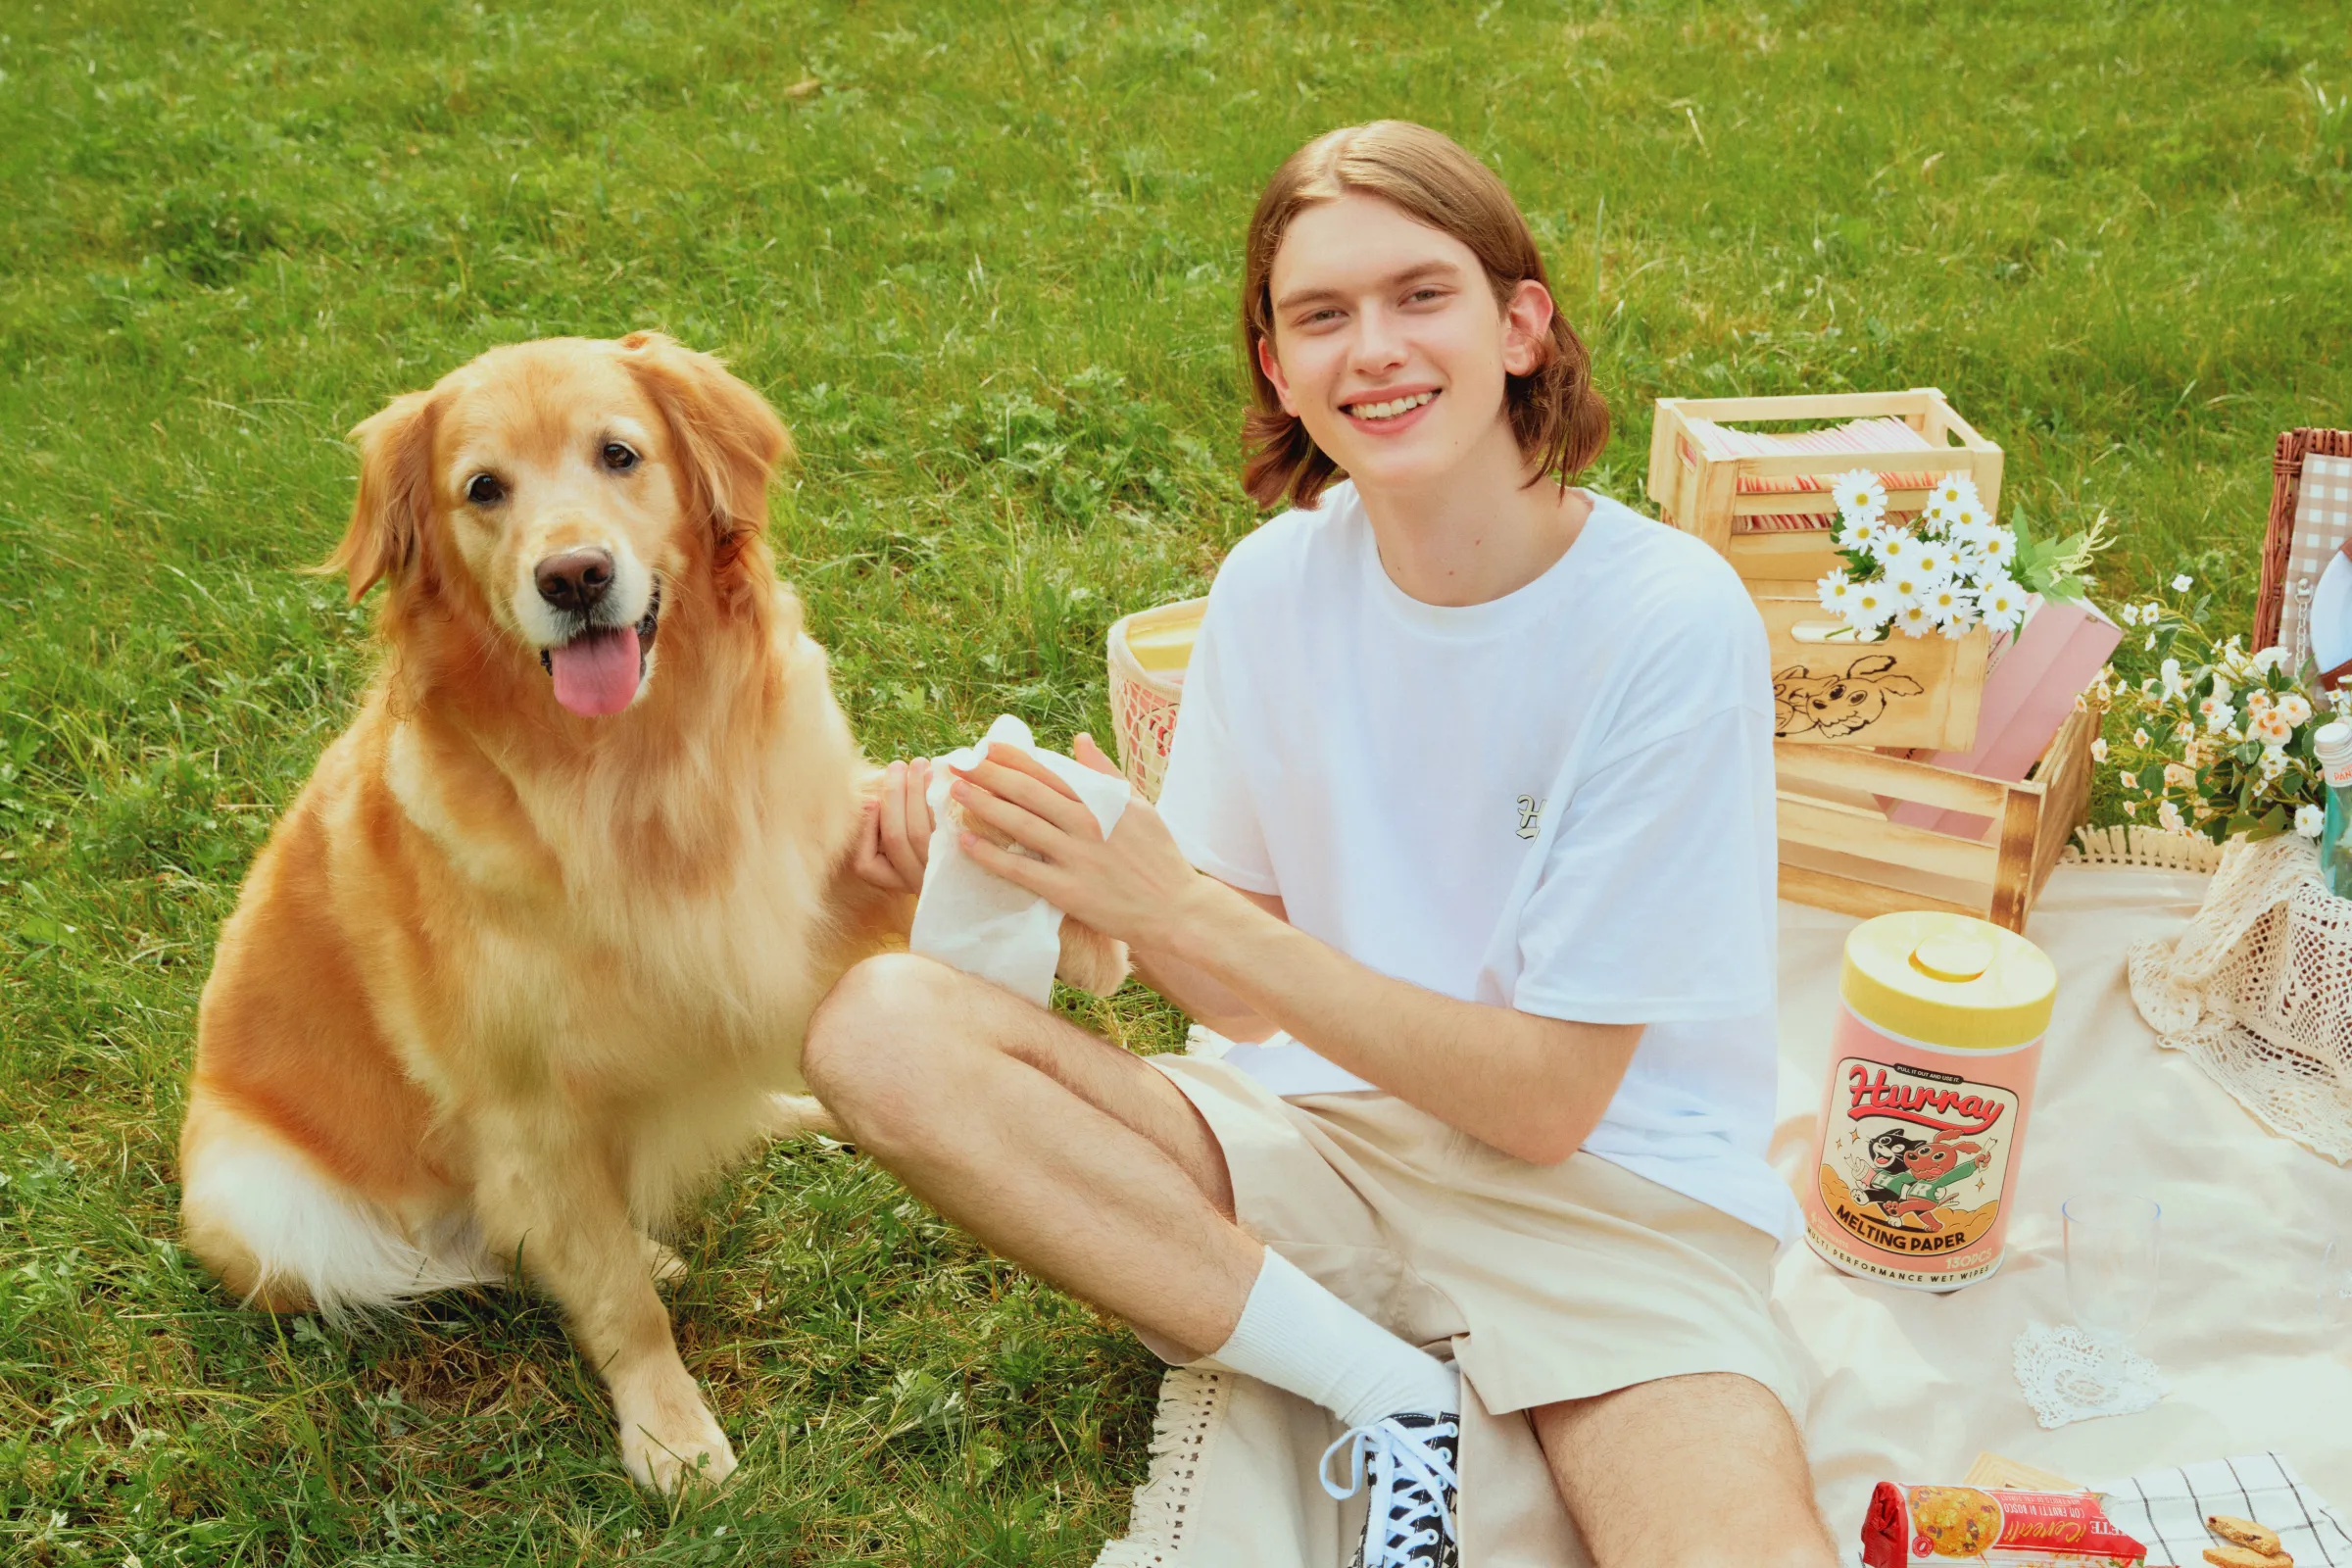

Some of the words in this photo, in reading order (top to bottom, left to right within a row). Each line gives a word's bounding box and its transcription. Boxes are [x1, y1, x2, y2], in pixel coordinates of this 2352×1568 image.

[1897, 1065, 1910, 1074] PULL
[1847, 1064, 2005, 1129] Hurray
[1836, 1203, 1907, 1250] MELTING
[1910, 1231, 1966, 1251] PAPER
[1807, 1226, 1830, 1251] MULTI
[1833, 1249, 1924, 1283] PERFORMANCE
[1930, 1274, 1955, 1283] WET
[1960, 1264, 1990, 1280] WIPES
[2003, 1502, 2028, 1514] BOSCO
[2039, 1505, 2068, 1518] FRUTTI
